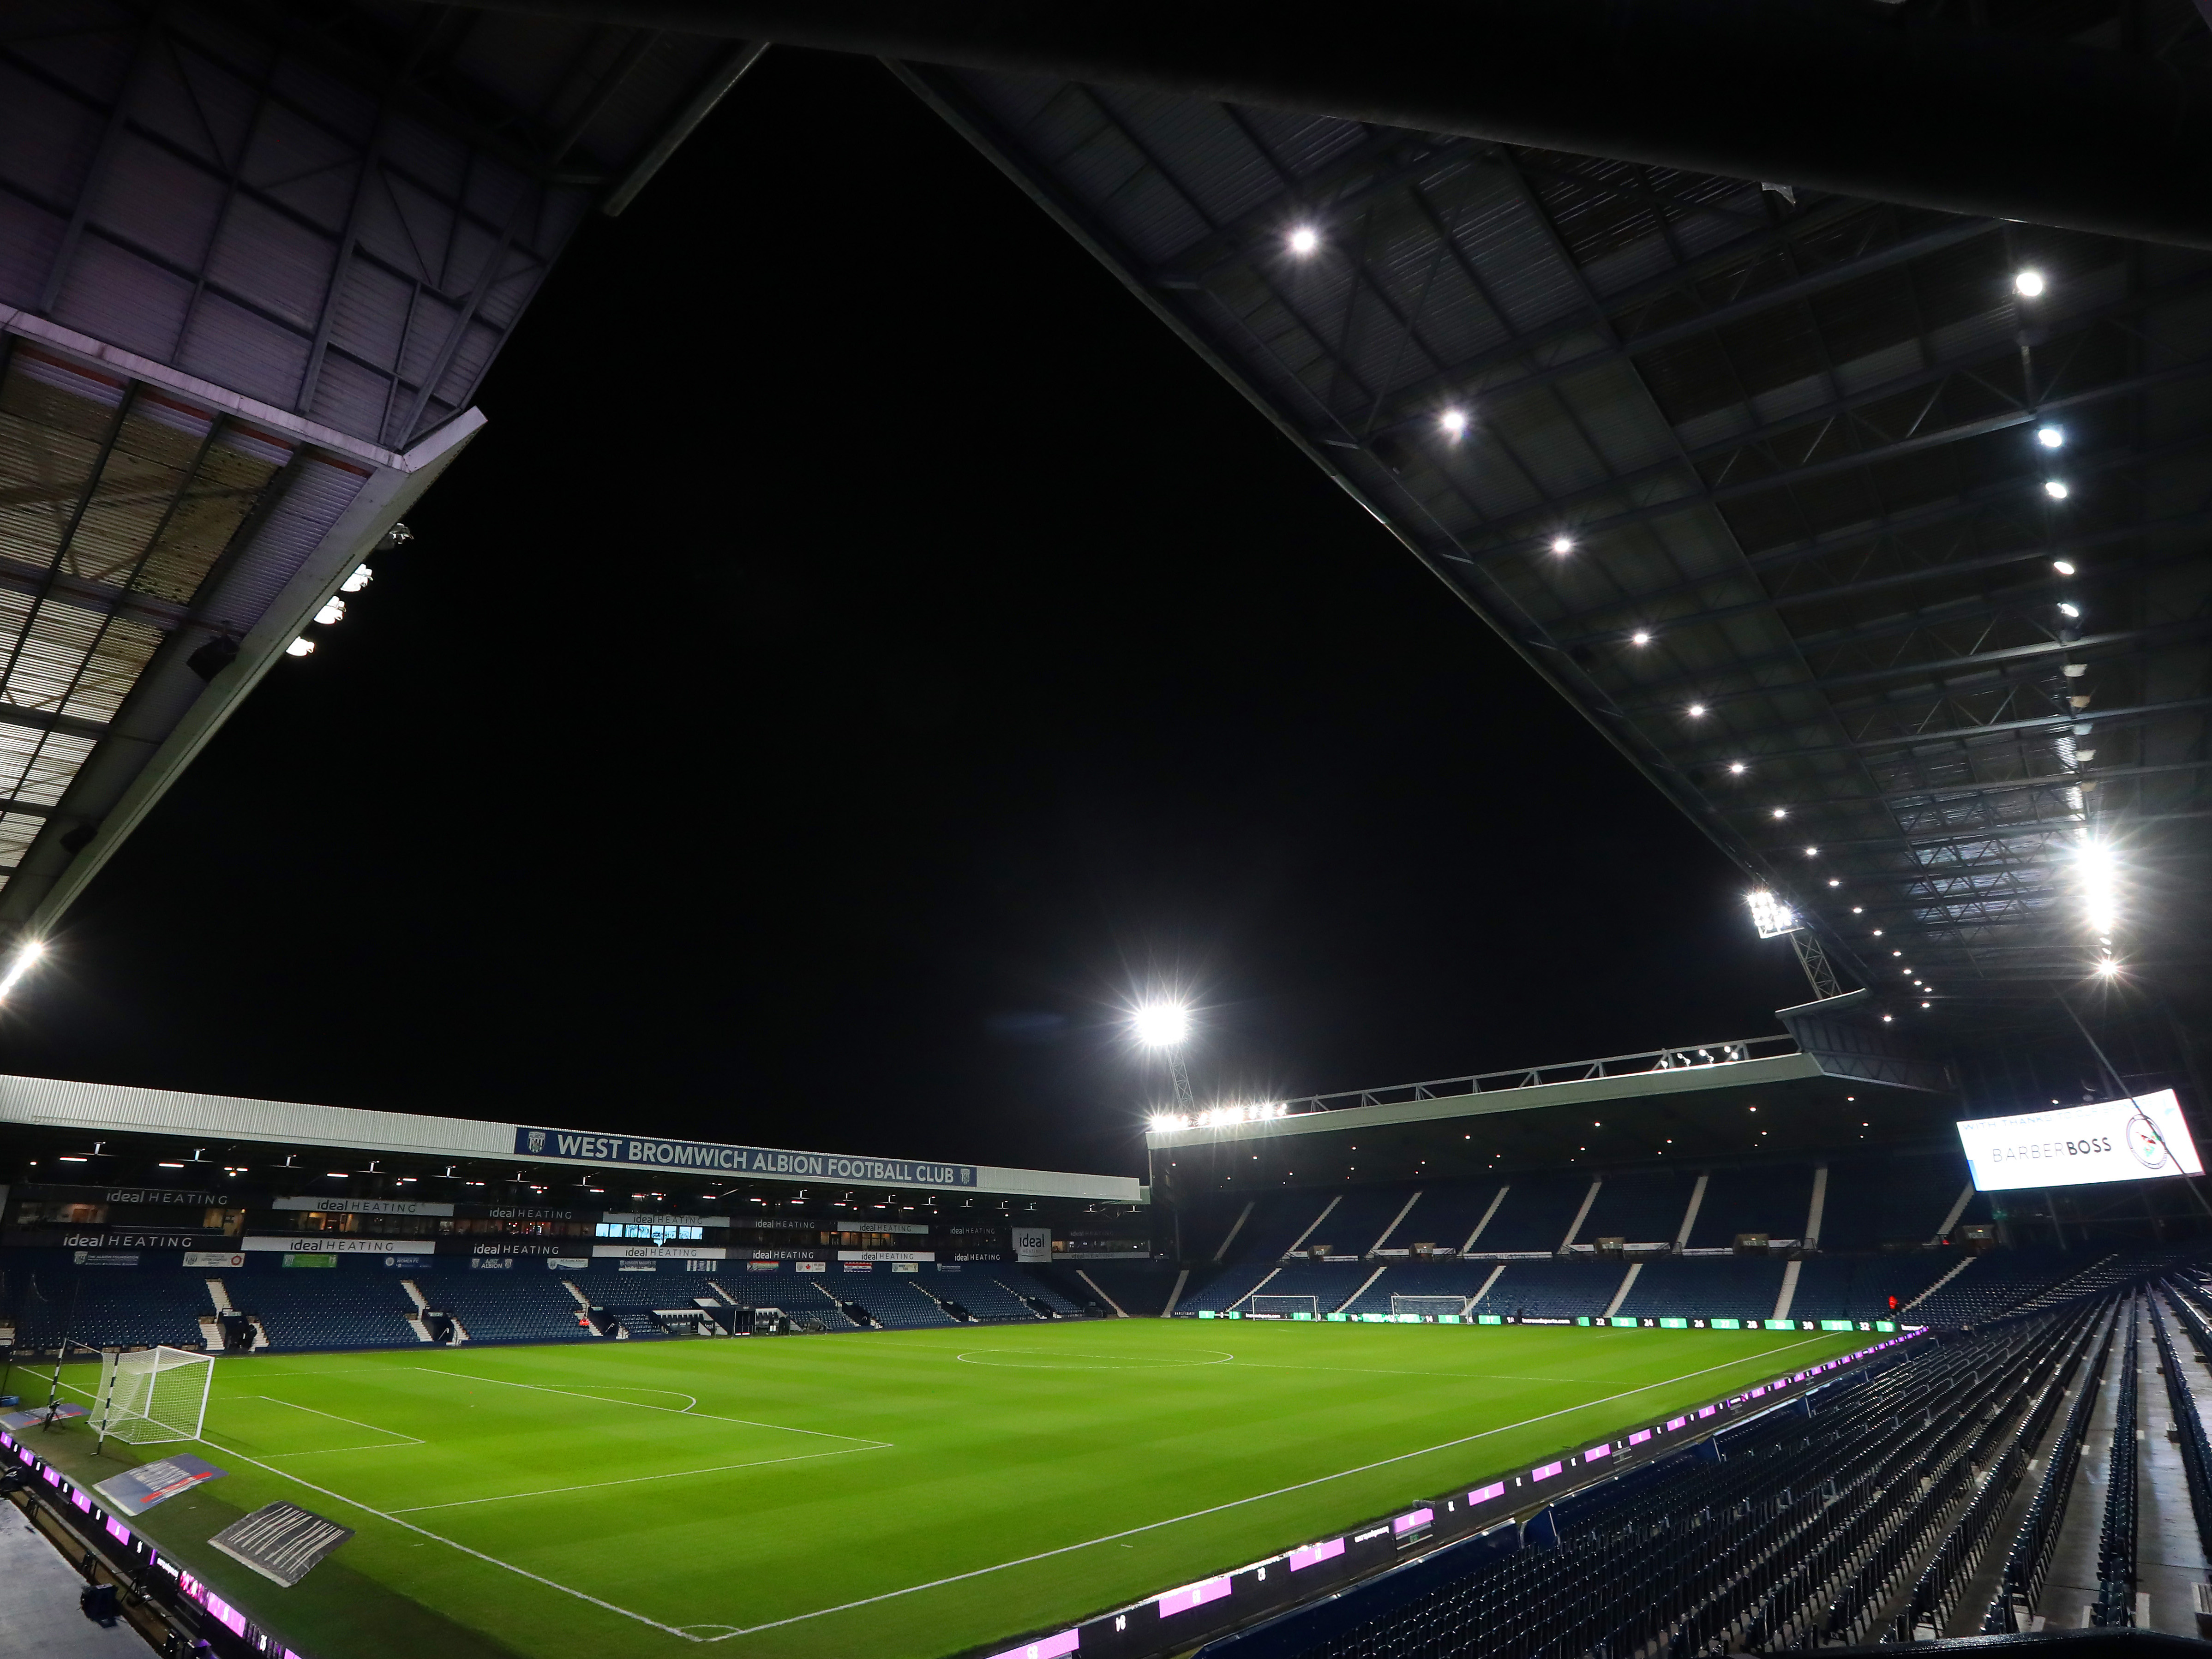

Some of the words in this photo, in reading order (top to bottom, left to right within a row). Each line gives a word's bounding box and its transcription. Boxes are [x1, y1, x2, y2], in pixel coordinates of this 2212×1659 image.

[1962, 1122, 1996, 1130] WITH
[2002, 1114, 2052, 1126] THANKS
[557, 1134, 622, 1159] WEST
[628, 1141, 747, 1169] BROMWICH
[752, 1153, 822, 1174] ALBION
[828, 1159, 912, 1181] FOOTBALL
[916, 1165, 954, 1183] CLUB
[106, 1190, 144, 1203] ideal
[149, 1192, 228, 1205] HEATING
[317, 1200, 348, 1211] ideal
[352, 1202, 416, 1213] HEATING
[489, 1207, 515, 1218] ideal
[518, 1210, 572, 1219] HEATING
[755, 1219, 773, 1228] ideal
[63, 1233, 104, 1246] ideal
[108, 1236, 192, 1247] HEATING
[290, 1239, 322, 1251] ideal
[326, 1241, 394, 1251] HEATING
[1019, 1233, 1045, 1247] ideal
[474, 1243, 500, 1254] ideal
[503, 1246, 559, 1255] HEATING
[625, 1247, 647, 1257] ideal
[753, 1250, 772, 1259] ideal
[1643, 1318, 1654, 1327] 24
[1694, 1319, 1705, 1328] 26
[1747, 1320, 1758, 1329] 28
[1802, 1321, 1814, 1330] 30
[1859, 1322, 1870, 1331] 32
